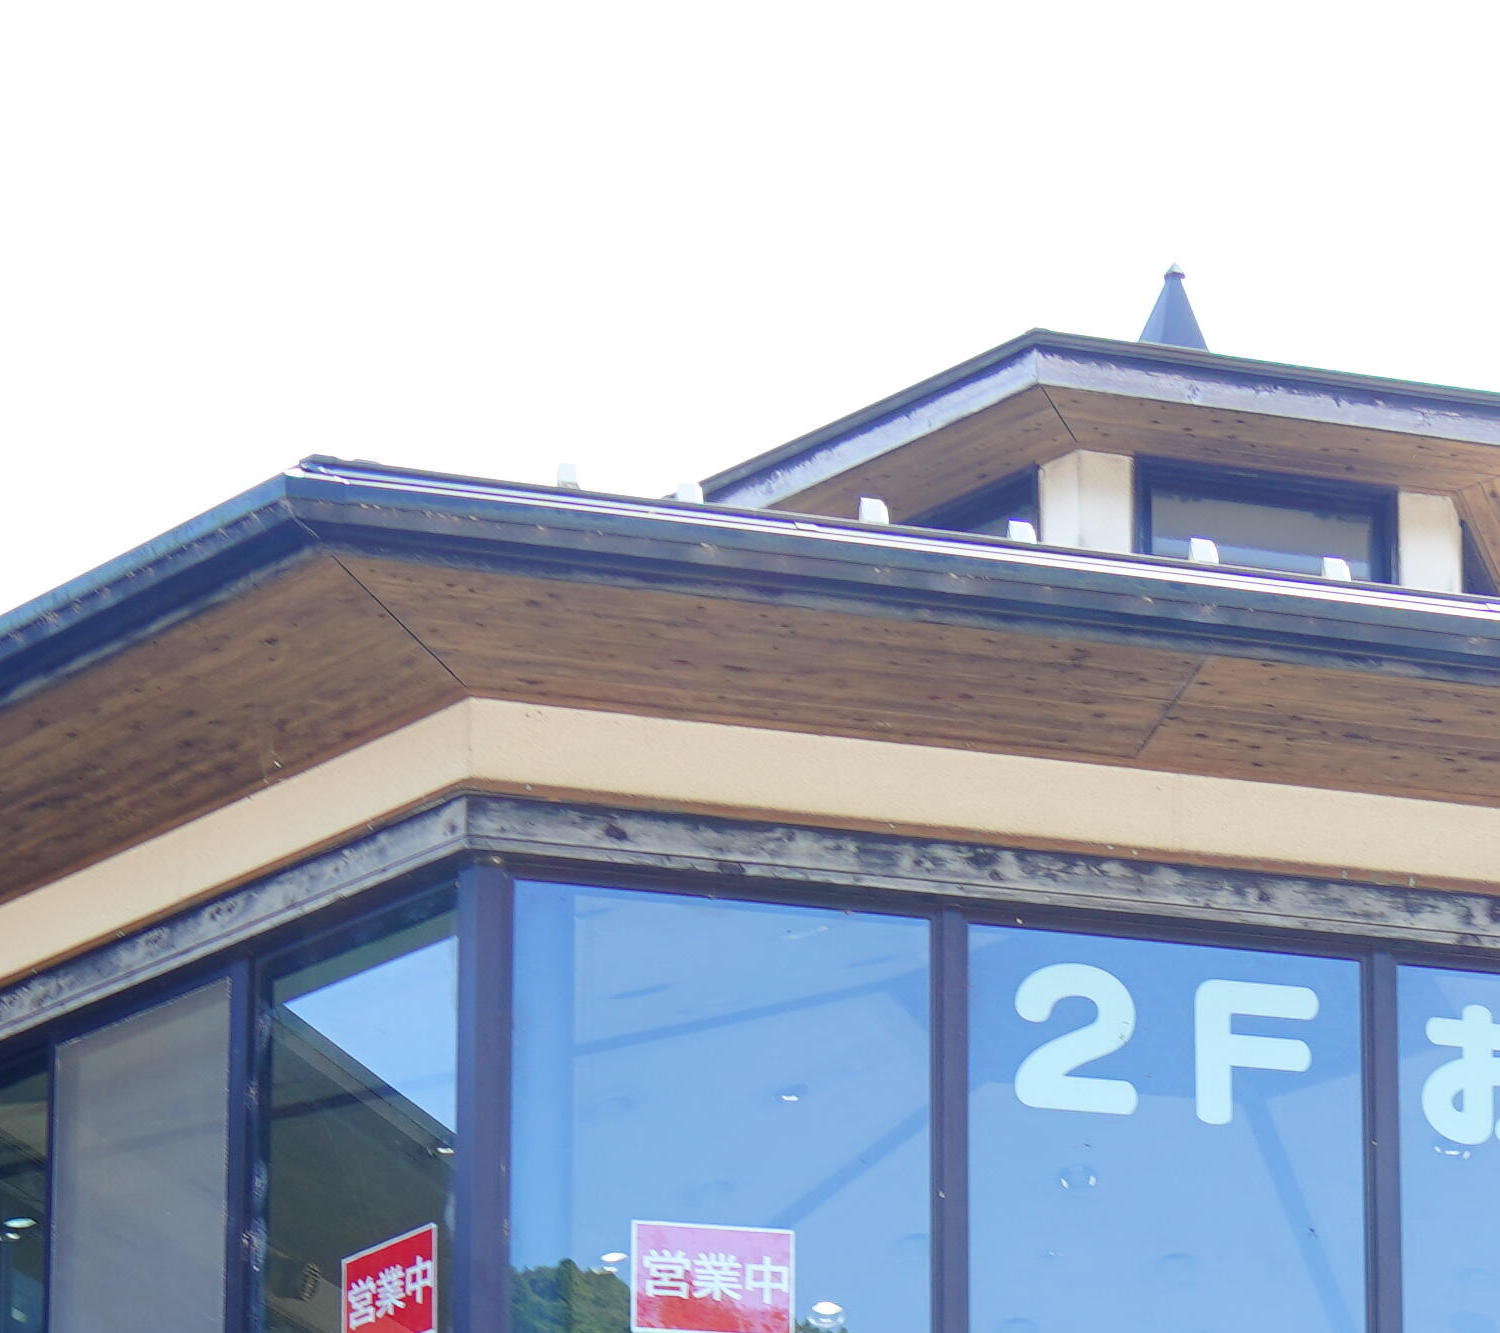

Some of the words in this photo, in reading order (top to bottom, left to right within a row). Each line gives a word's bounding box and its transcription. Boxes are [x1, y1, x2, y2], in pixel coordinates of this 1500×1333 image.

[1012, 962, 1320, 1128] 2F
[346, 1255, 434, 1331] 営業中
[639, 1246, 791, 1307] 営業中
